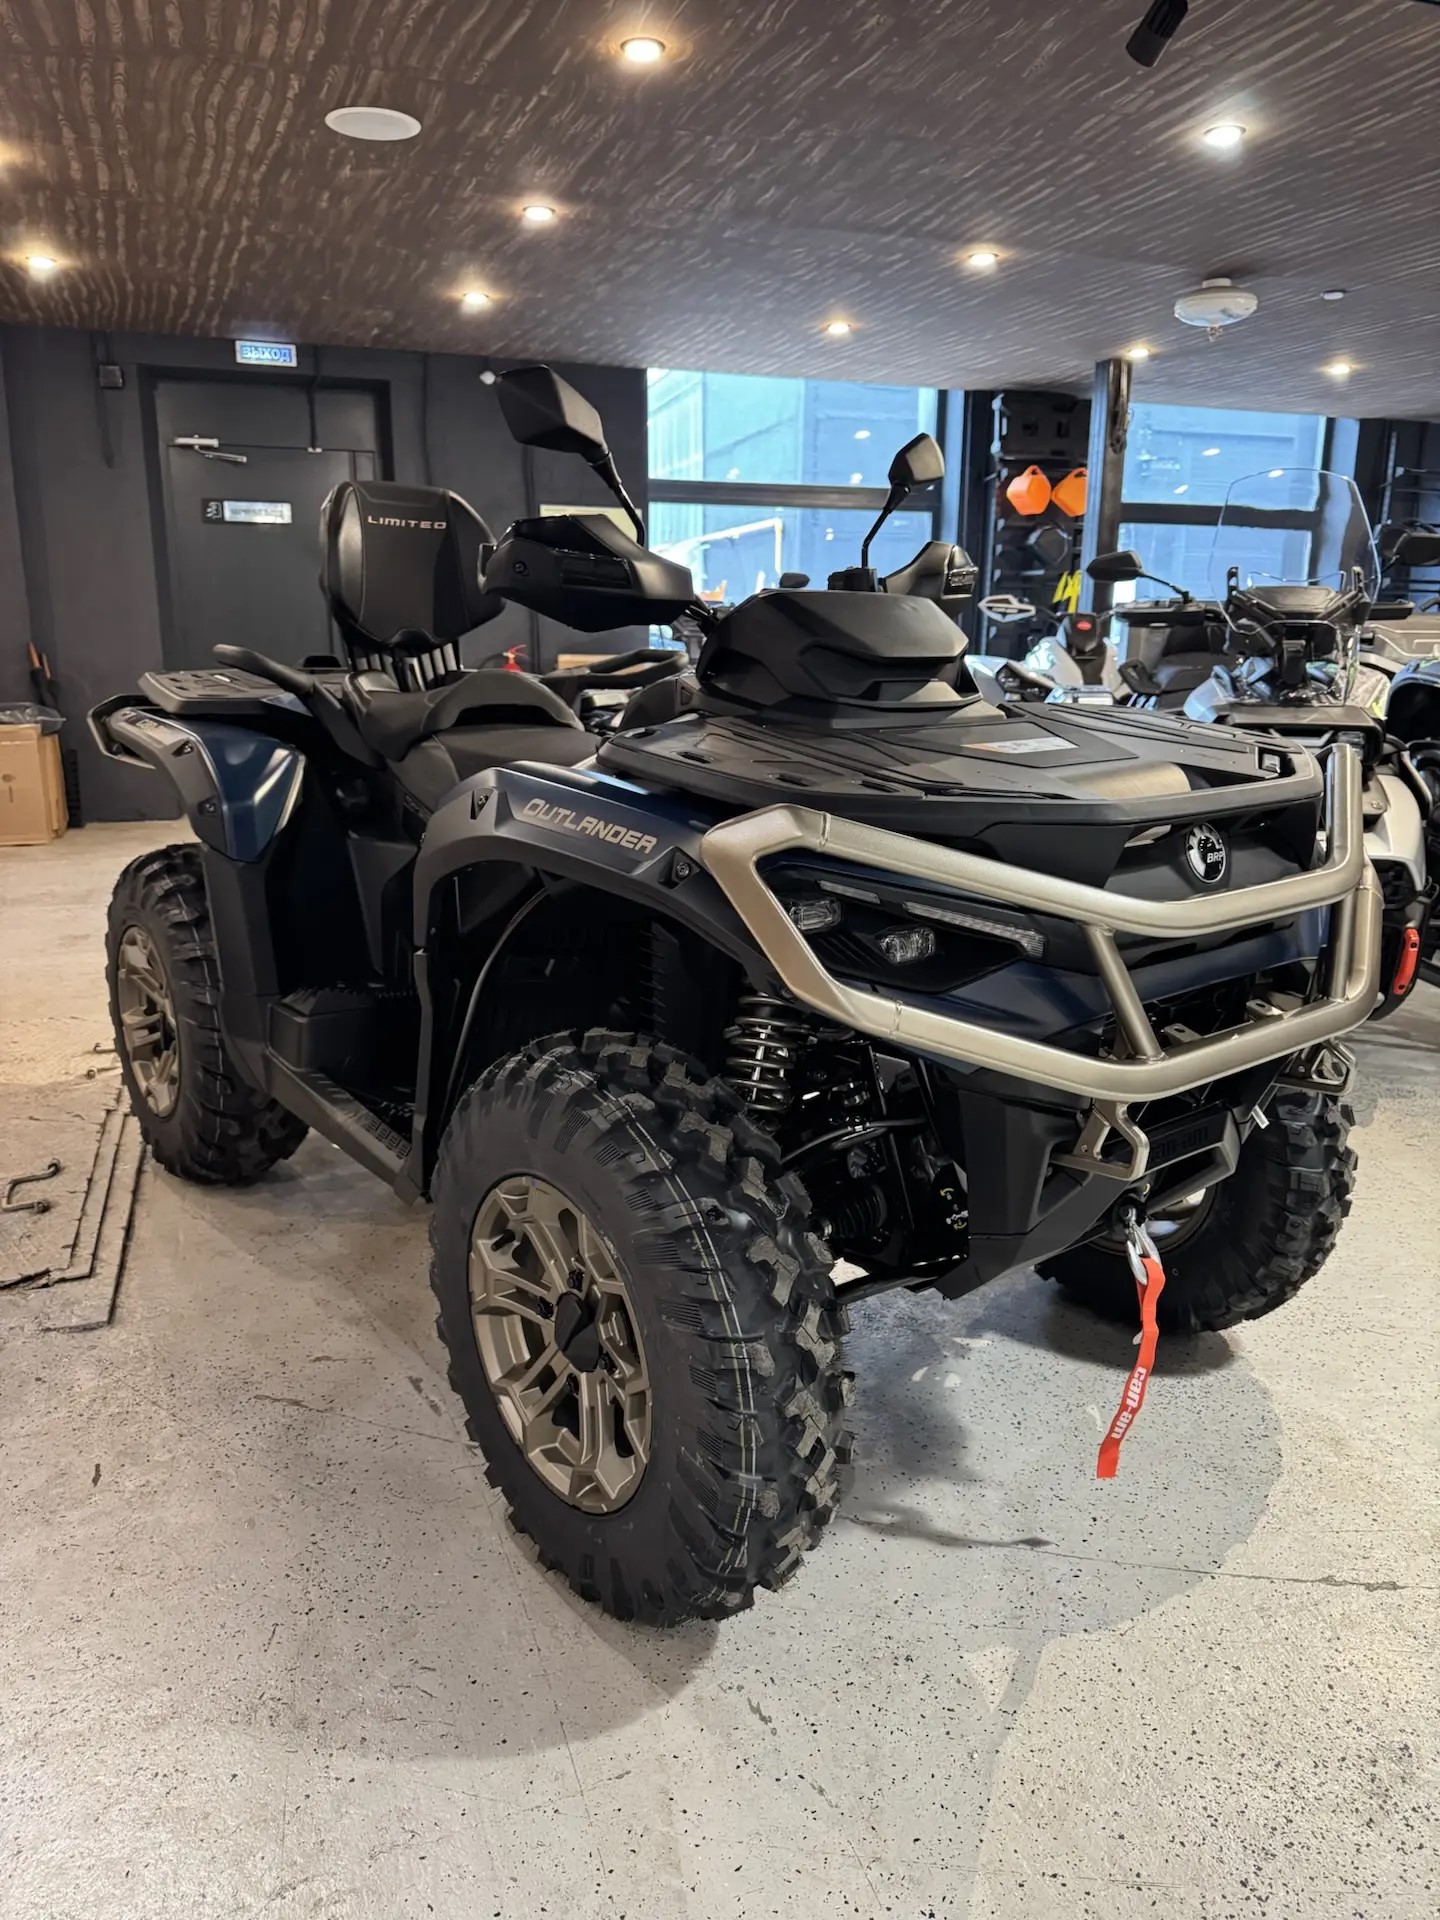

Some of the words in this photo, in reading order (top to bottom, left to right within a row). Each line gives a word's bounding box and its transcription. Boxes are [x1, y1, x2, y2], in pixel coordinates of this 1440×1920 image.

[242, 346, 291, 362] ВЫХОД
[367, 515, 447, 529] LIMITED
[522, 797, 658, 854] OUTLANDER
[1206, 851, 1224, 863] BRP
[1111, 1367, 1146, 1440] can-am
